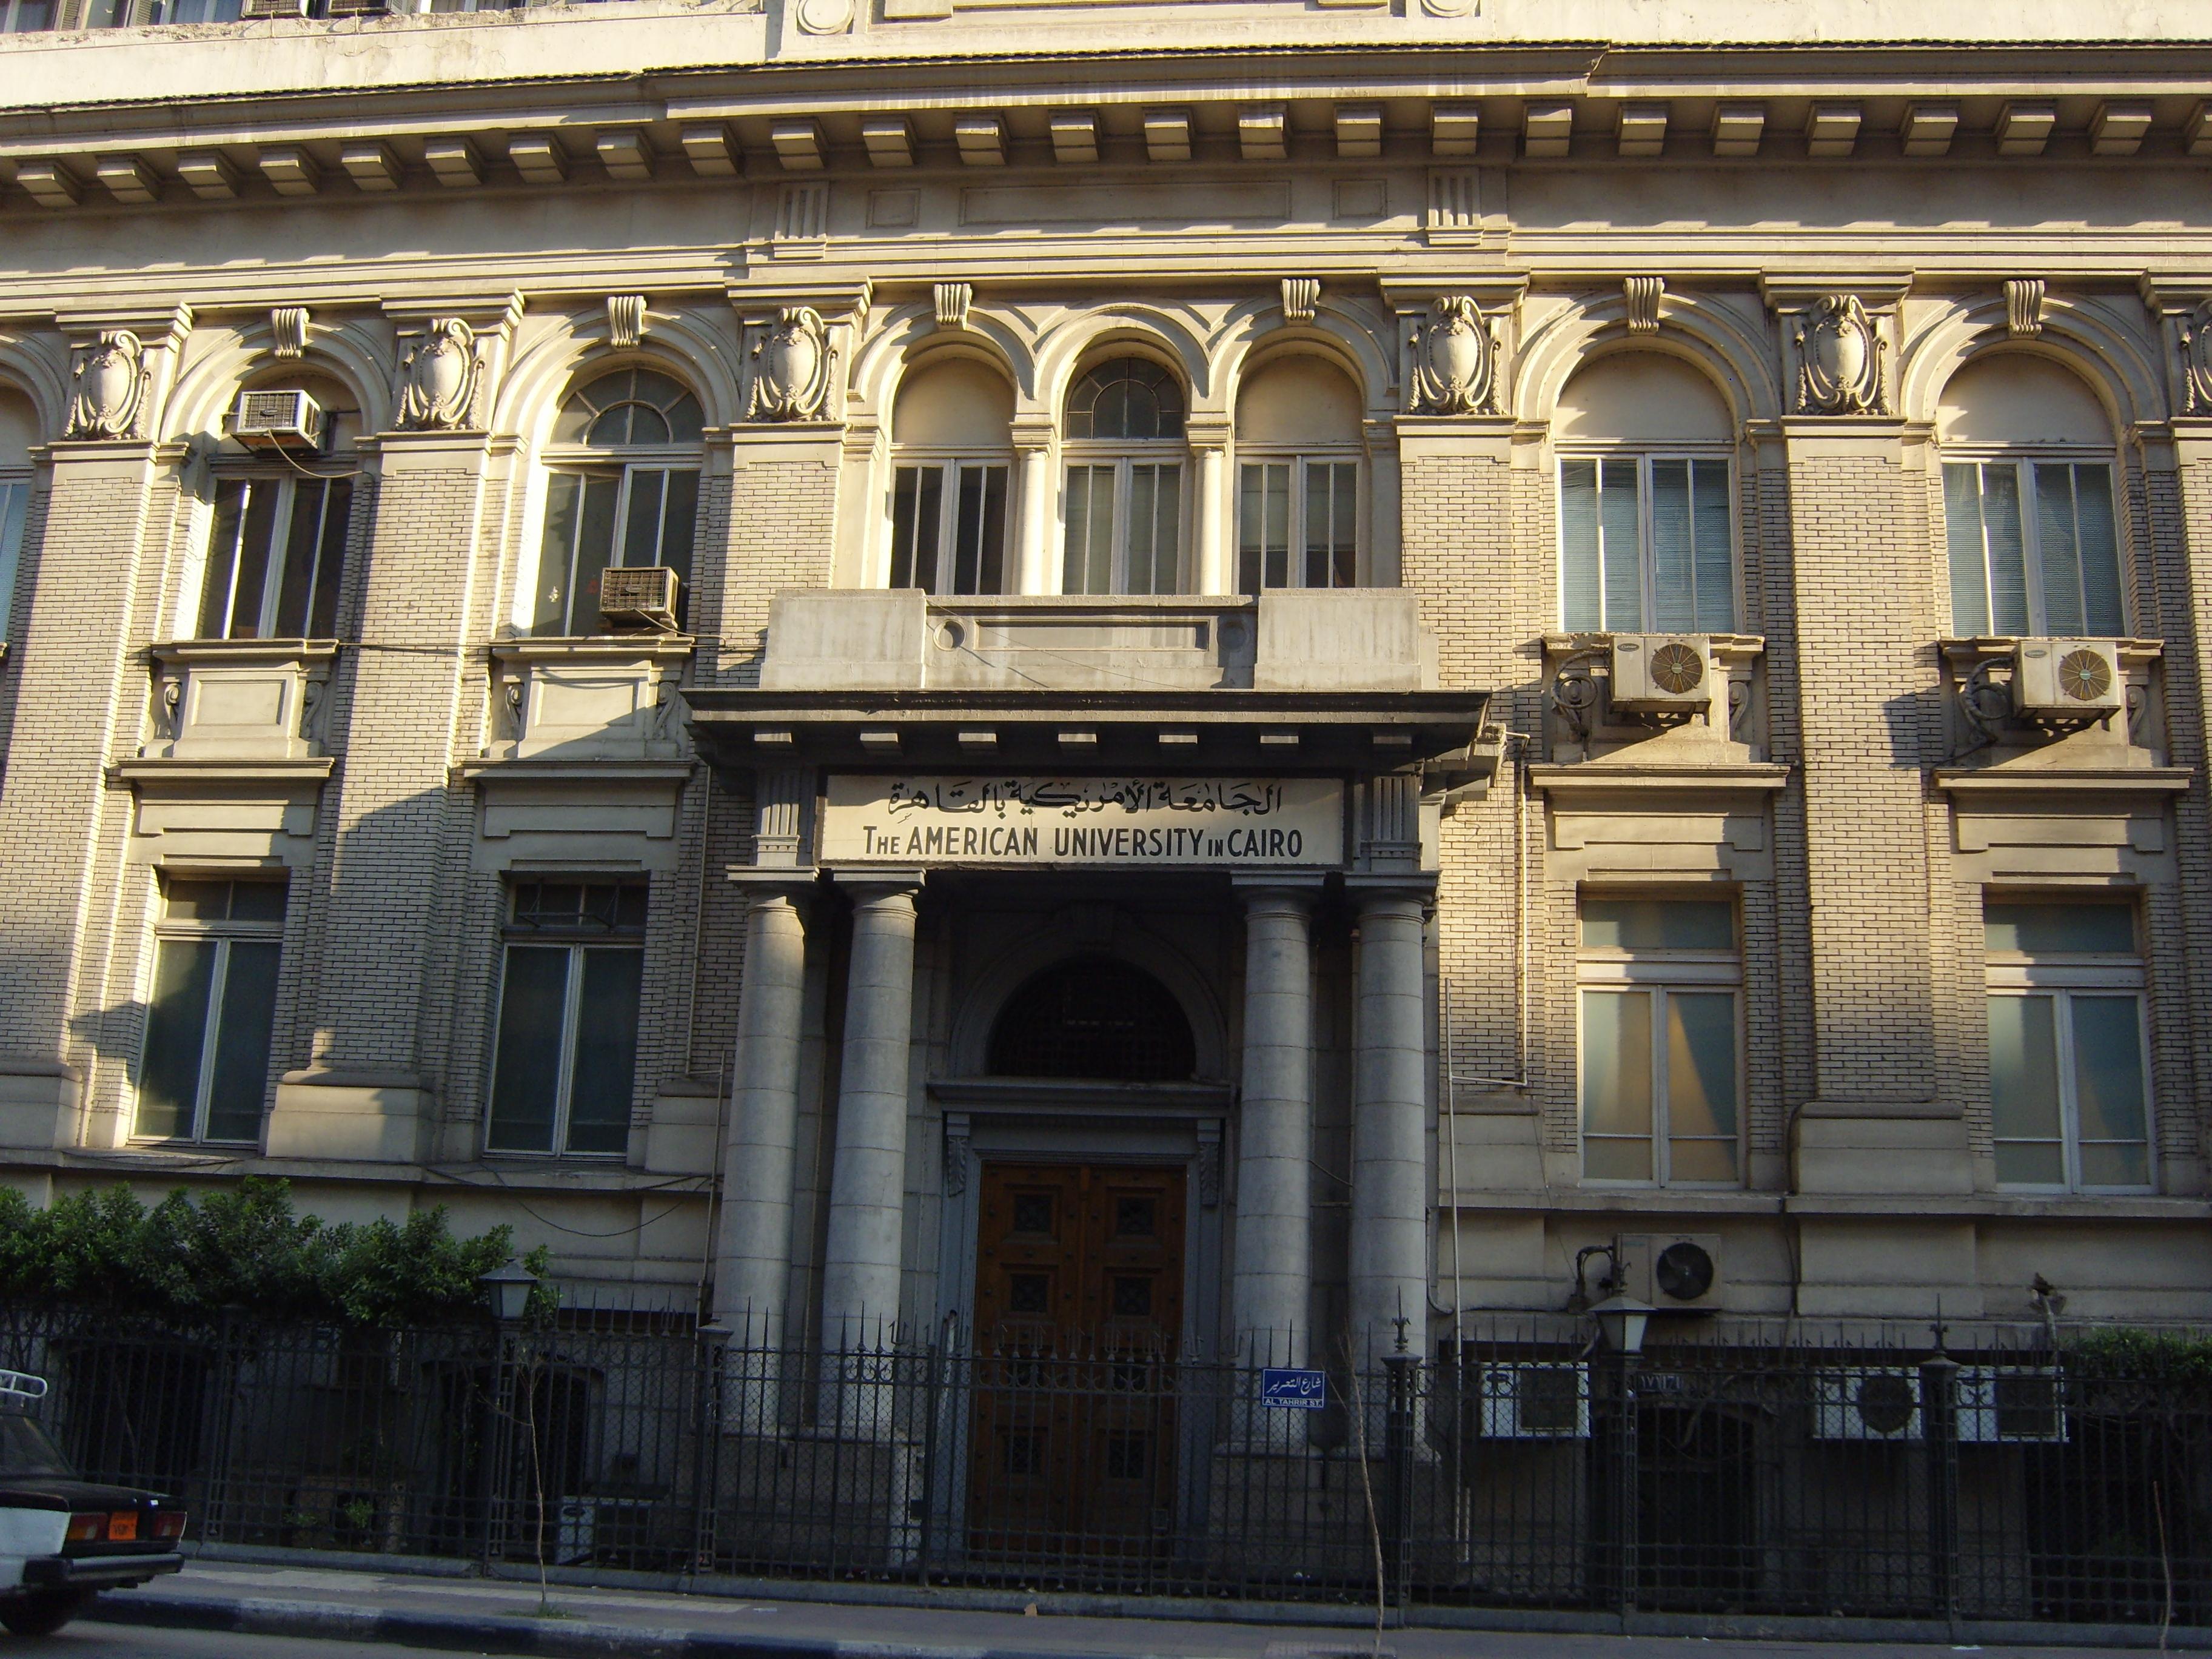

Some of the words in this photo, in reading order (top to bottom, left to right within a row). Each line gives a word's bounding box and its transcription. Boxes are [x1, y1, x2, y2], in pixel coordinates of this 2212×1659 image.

[888, 780, 1007, 819] بالقاهرة
[1153, 781, 1282, 816] الجامعة
[906, 826, 1037, 856] AMERICAN
[1055, 828, 1204, 857] UNIVERSITY
[1208, 839, 1223, 857] IN
[1227, 828, 1302, 857] CAIRO
[1266, 1376, 1301, 1393] التحرير
[1300, 1376, 1321, 1395] شارع
